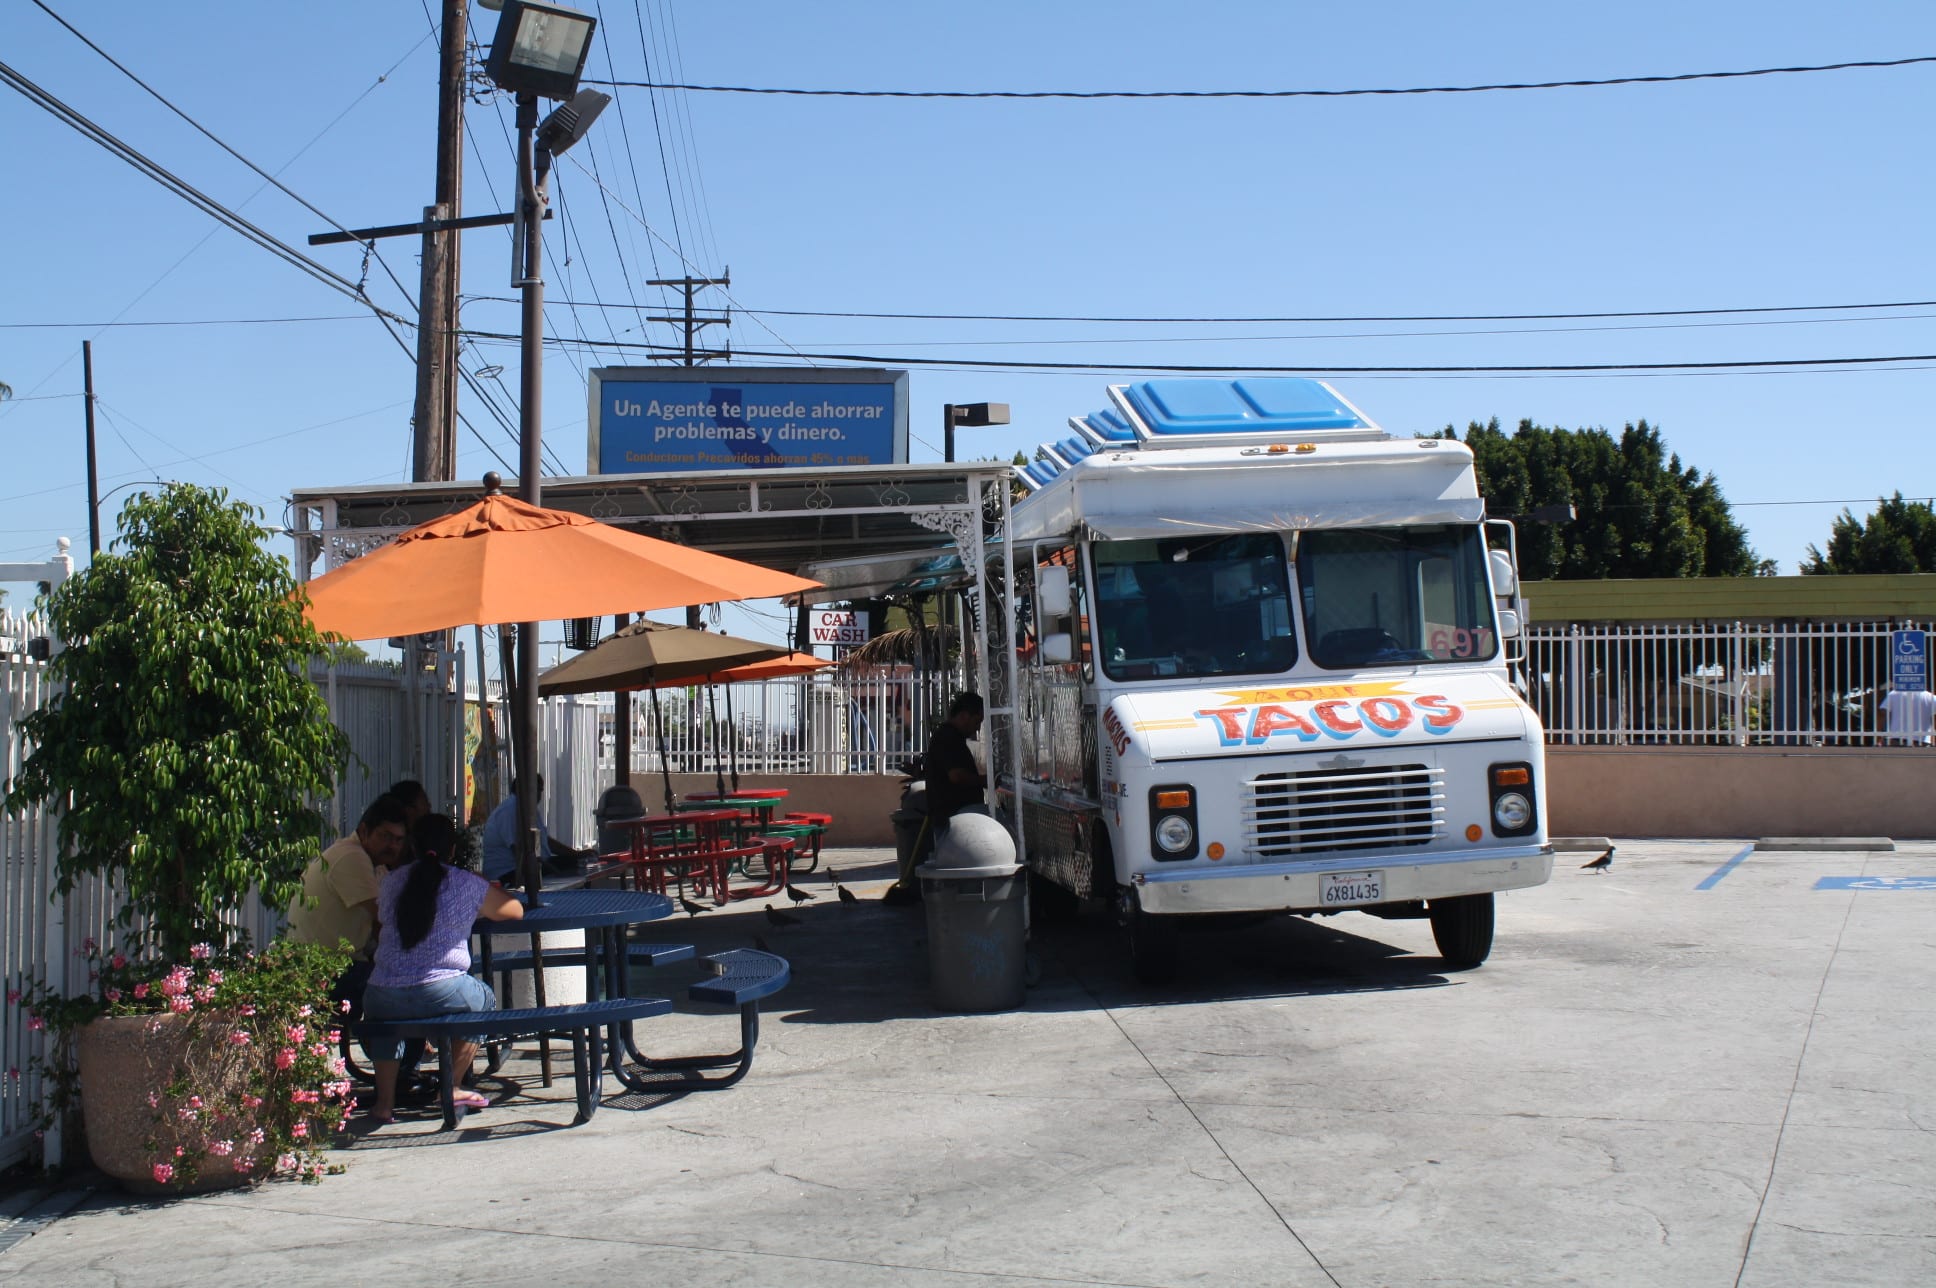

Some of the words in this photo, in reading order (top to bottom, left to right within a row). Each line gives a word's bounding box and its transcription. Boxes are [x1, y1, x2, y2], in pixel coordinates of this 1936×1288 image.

[614, 400, 641, 417] Un
[647, 400, 717, 420] Agente
[721, 402, 741, 418] te
[746, 400, 806, 421] puede
[811, 401, 884, 419] ahorrar
[654, 422, 757, 442] problemas
[761, 427, 773, 443] y
[778, 423, 846, 441] dinero.
[821, 613, 857, 627] CAR
[813, 628, 865, 642] WASH
[1431, 627, 1489, 657] 697
[1195, 694, 1465, 746] TACOS
[1326, 883, 1379, 902] 6X81435
